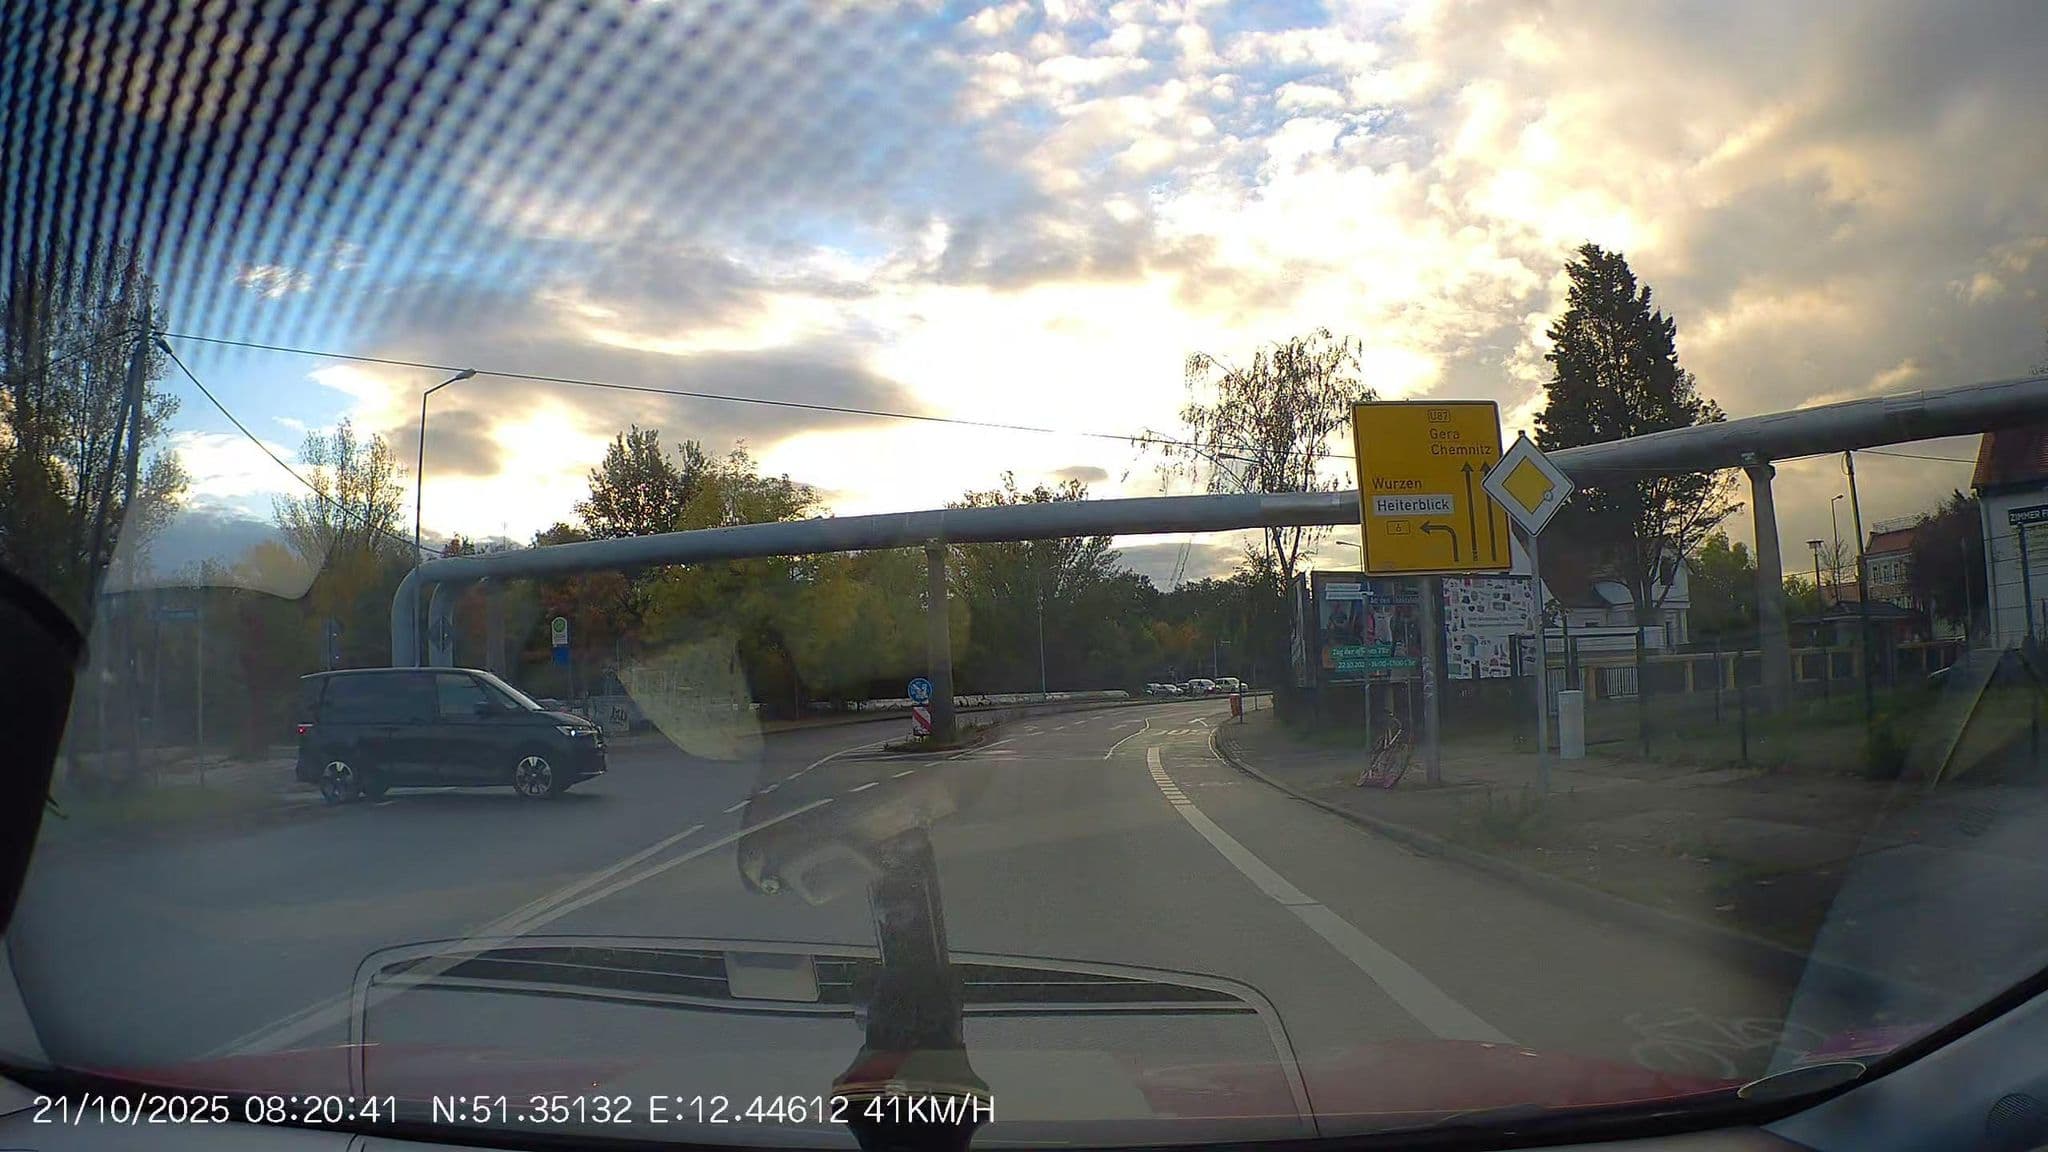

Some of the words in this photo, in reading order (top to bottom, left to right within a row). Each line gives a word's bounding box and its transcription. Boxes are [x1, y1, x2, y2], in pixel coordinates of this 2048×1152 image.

[1429, 428, 1460, 440] Gera
[1431, 443, 1492, 456] Chemnitz
[1372, 478, 1422, 490] Wurzen
[1377, 499, 1450, 512] Heiterblick
